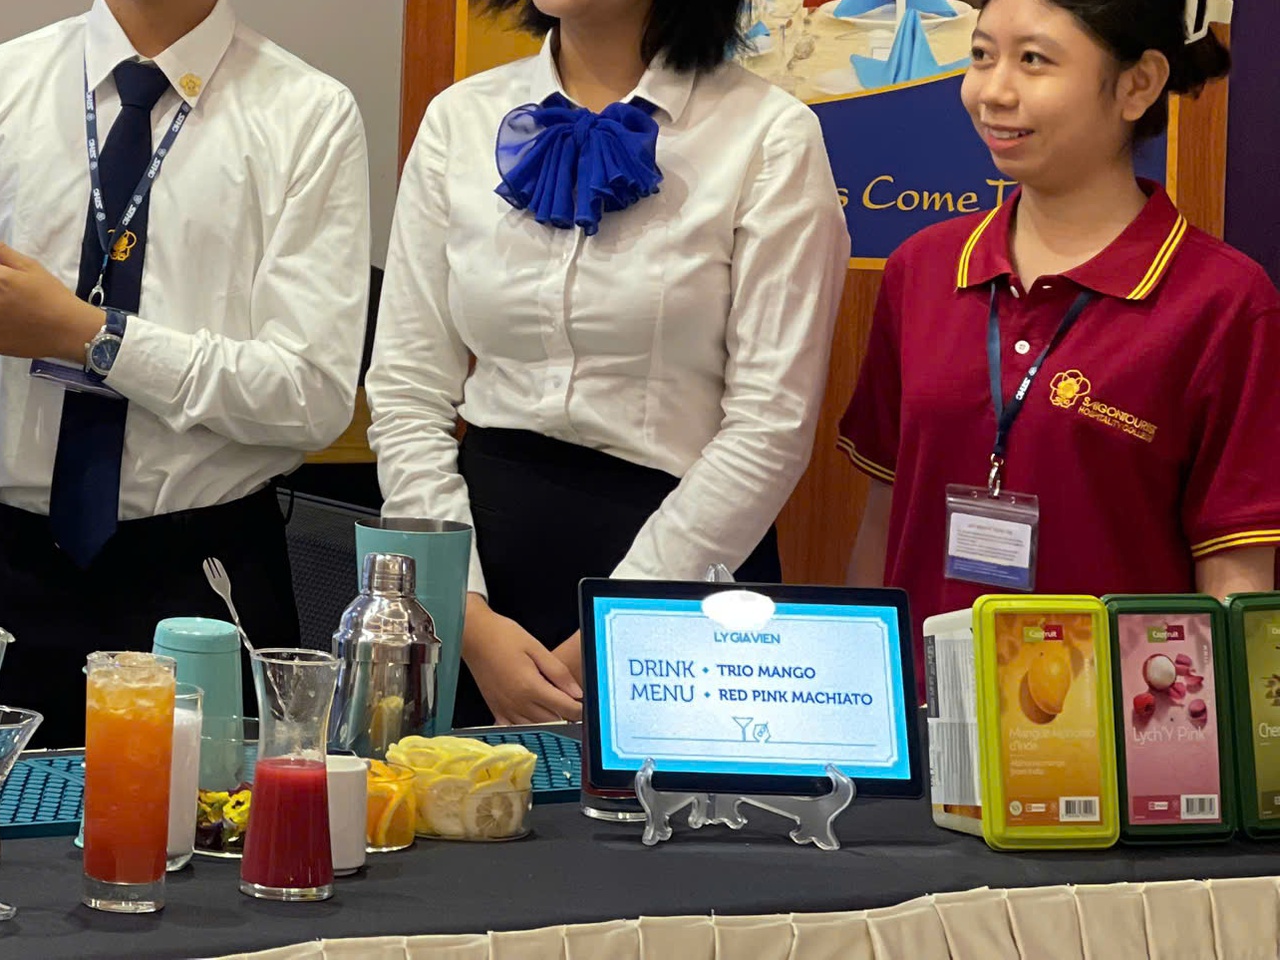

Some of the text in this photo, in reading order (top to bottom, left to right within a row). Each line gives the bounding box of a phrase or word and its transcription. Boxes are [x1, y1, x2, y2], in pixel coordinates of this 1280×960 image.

[862, 175, 981, 213] Come
[628, 659, 696, 678] DRINK
[716, 664, 816, 680] TRIO MANGO
[628, 684, 695, 703] MENU
[719, 688, 874, 707] RED PINK MACHIATO
[1177, 725, 1206, 742] Pink
